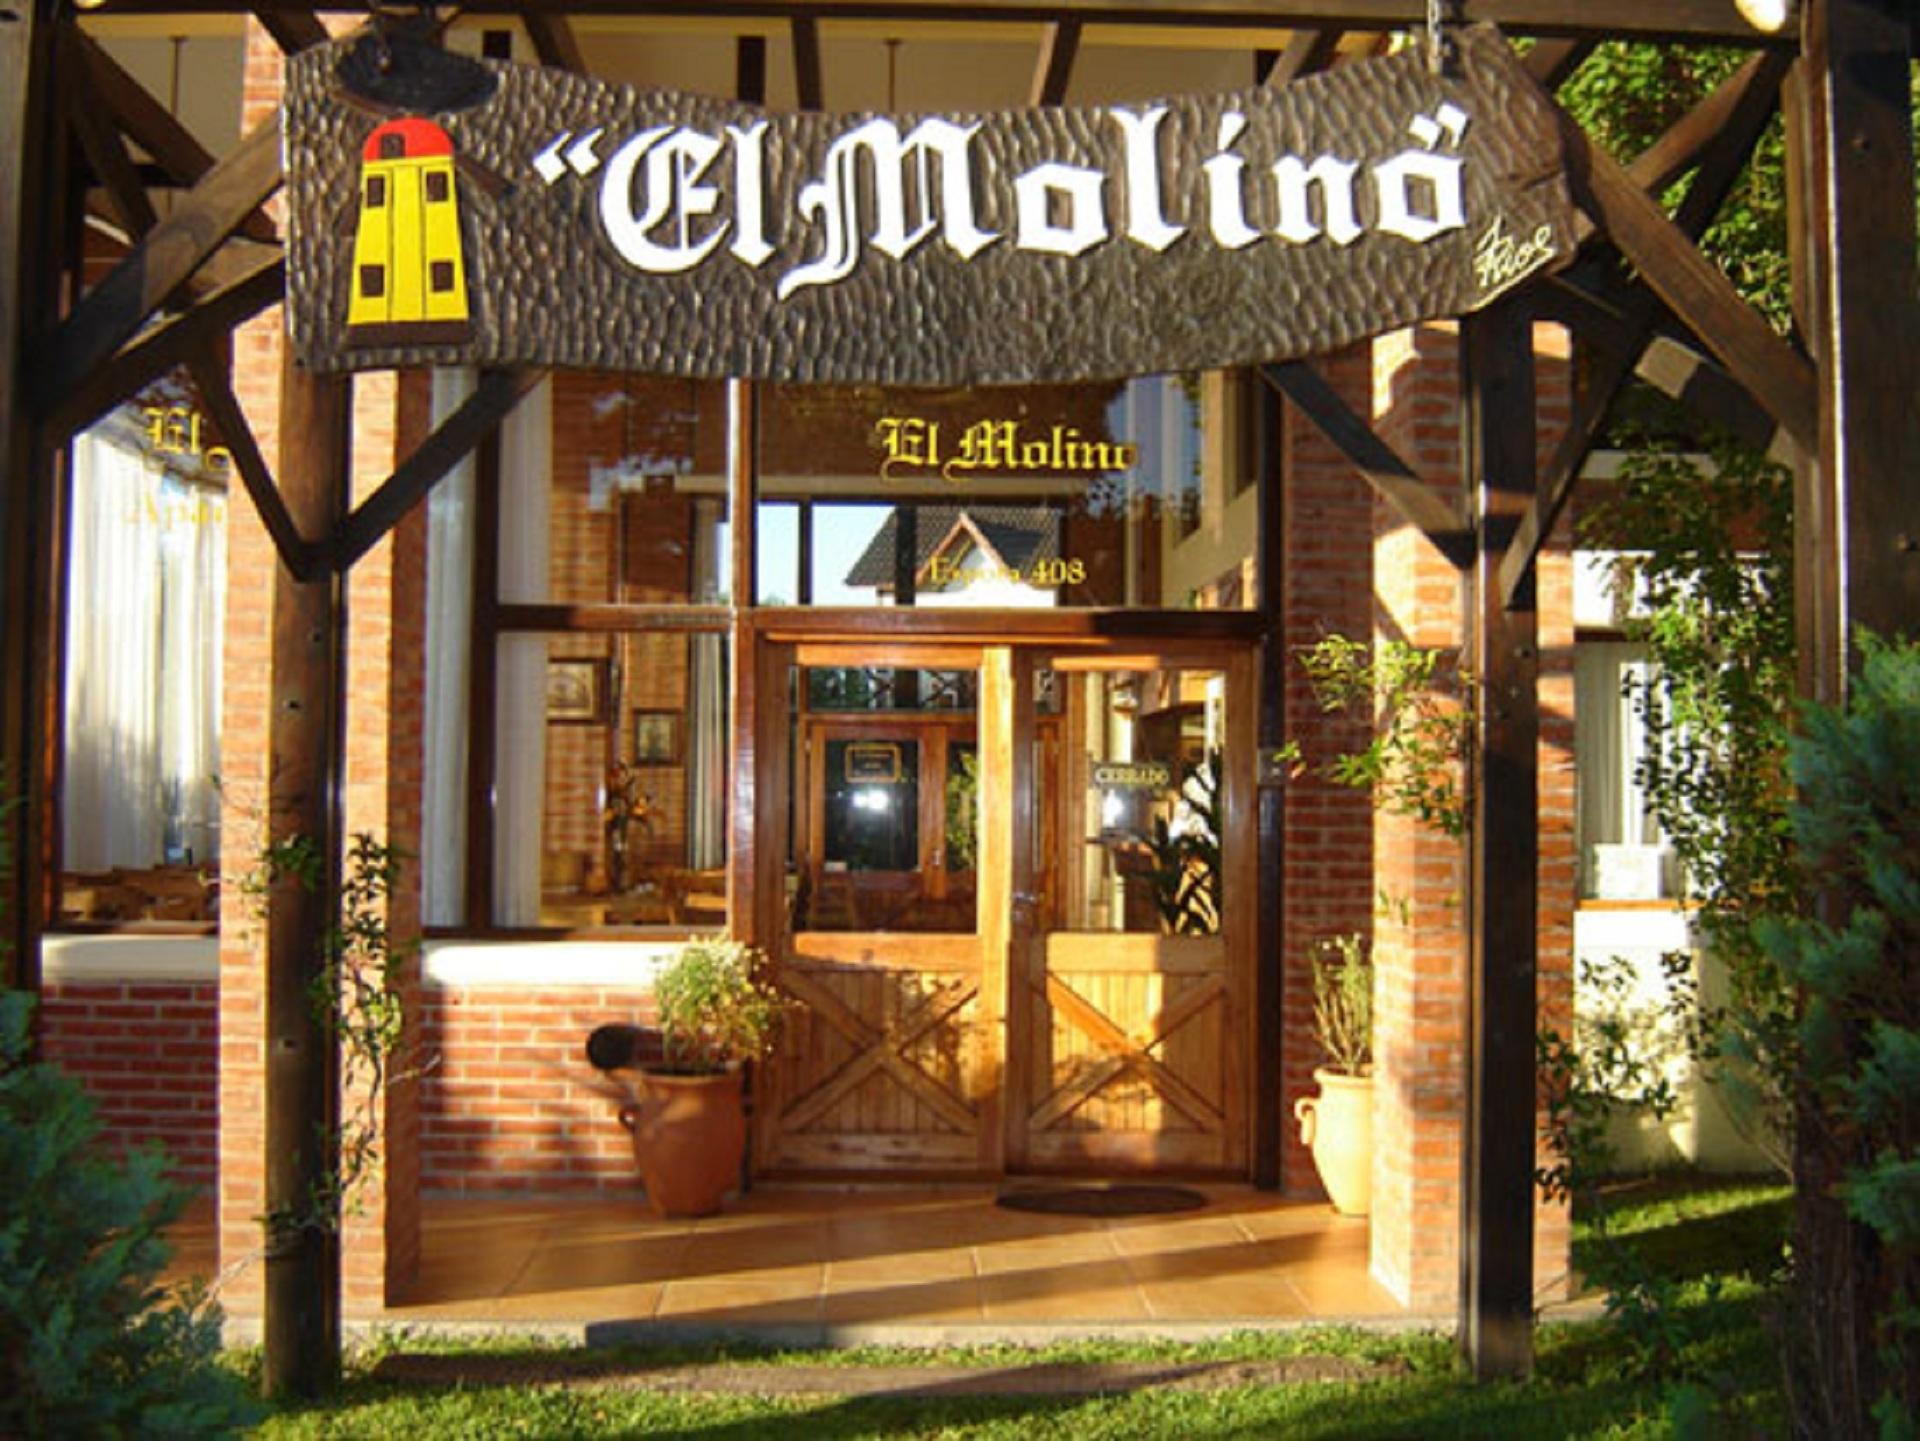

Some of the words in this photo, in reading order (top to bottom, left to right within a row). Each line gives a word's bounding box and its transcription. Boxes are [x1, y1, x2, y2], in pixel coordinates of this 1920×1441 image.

[143, 406, 200, 472] El
[875, 417, 939, 481] El
[942, 419, 1138, 481] Molino
[1032, 557, 1087, 585] 408
